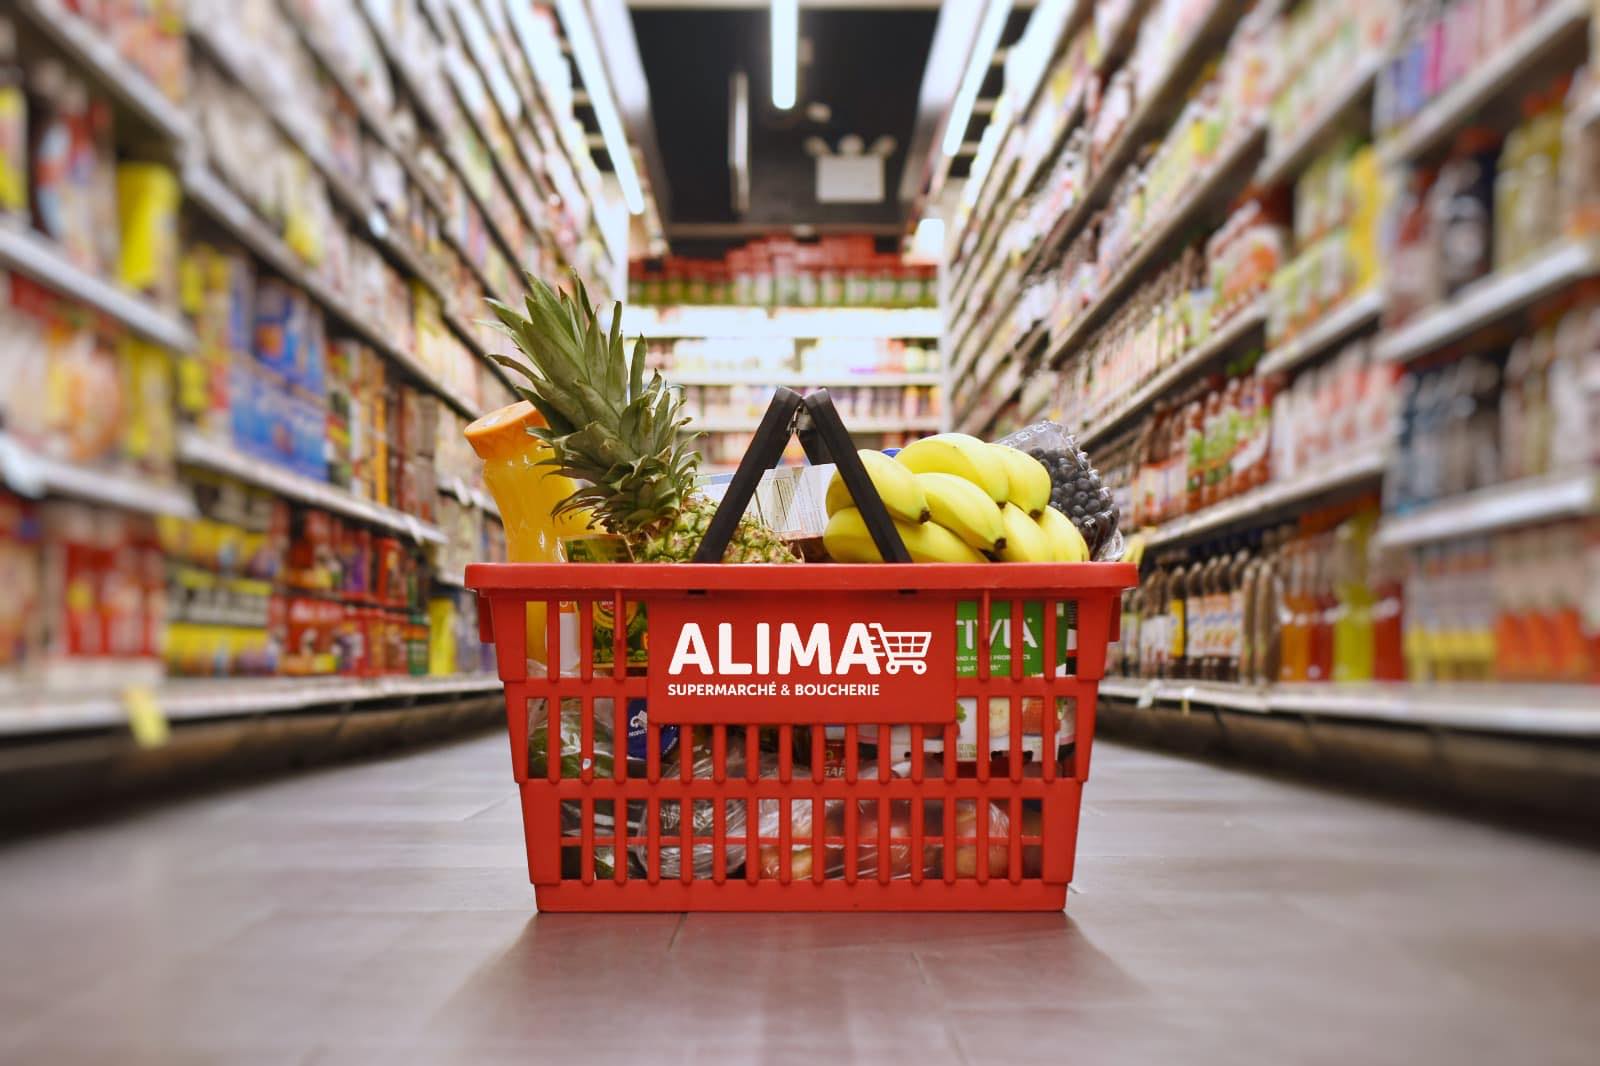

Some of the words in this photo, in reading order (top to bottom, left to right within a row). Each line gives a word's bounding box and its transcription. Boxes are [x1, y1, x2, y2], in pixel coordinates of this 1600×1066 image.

[668, 623, 880, 675] ALIMA
[668, 681, 777, 696] SUPERMARCHÉ
[781, 684, 790, 696] &
[795, 684, 880, 696] BOUCHERIE
